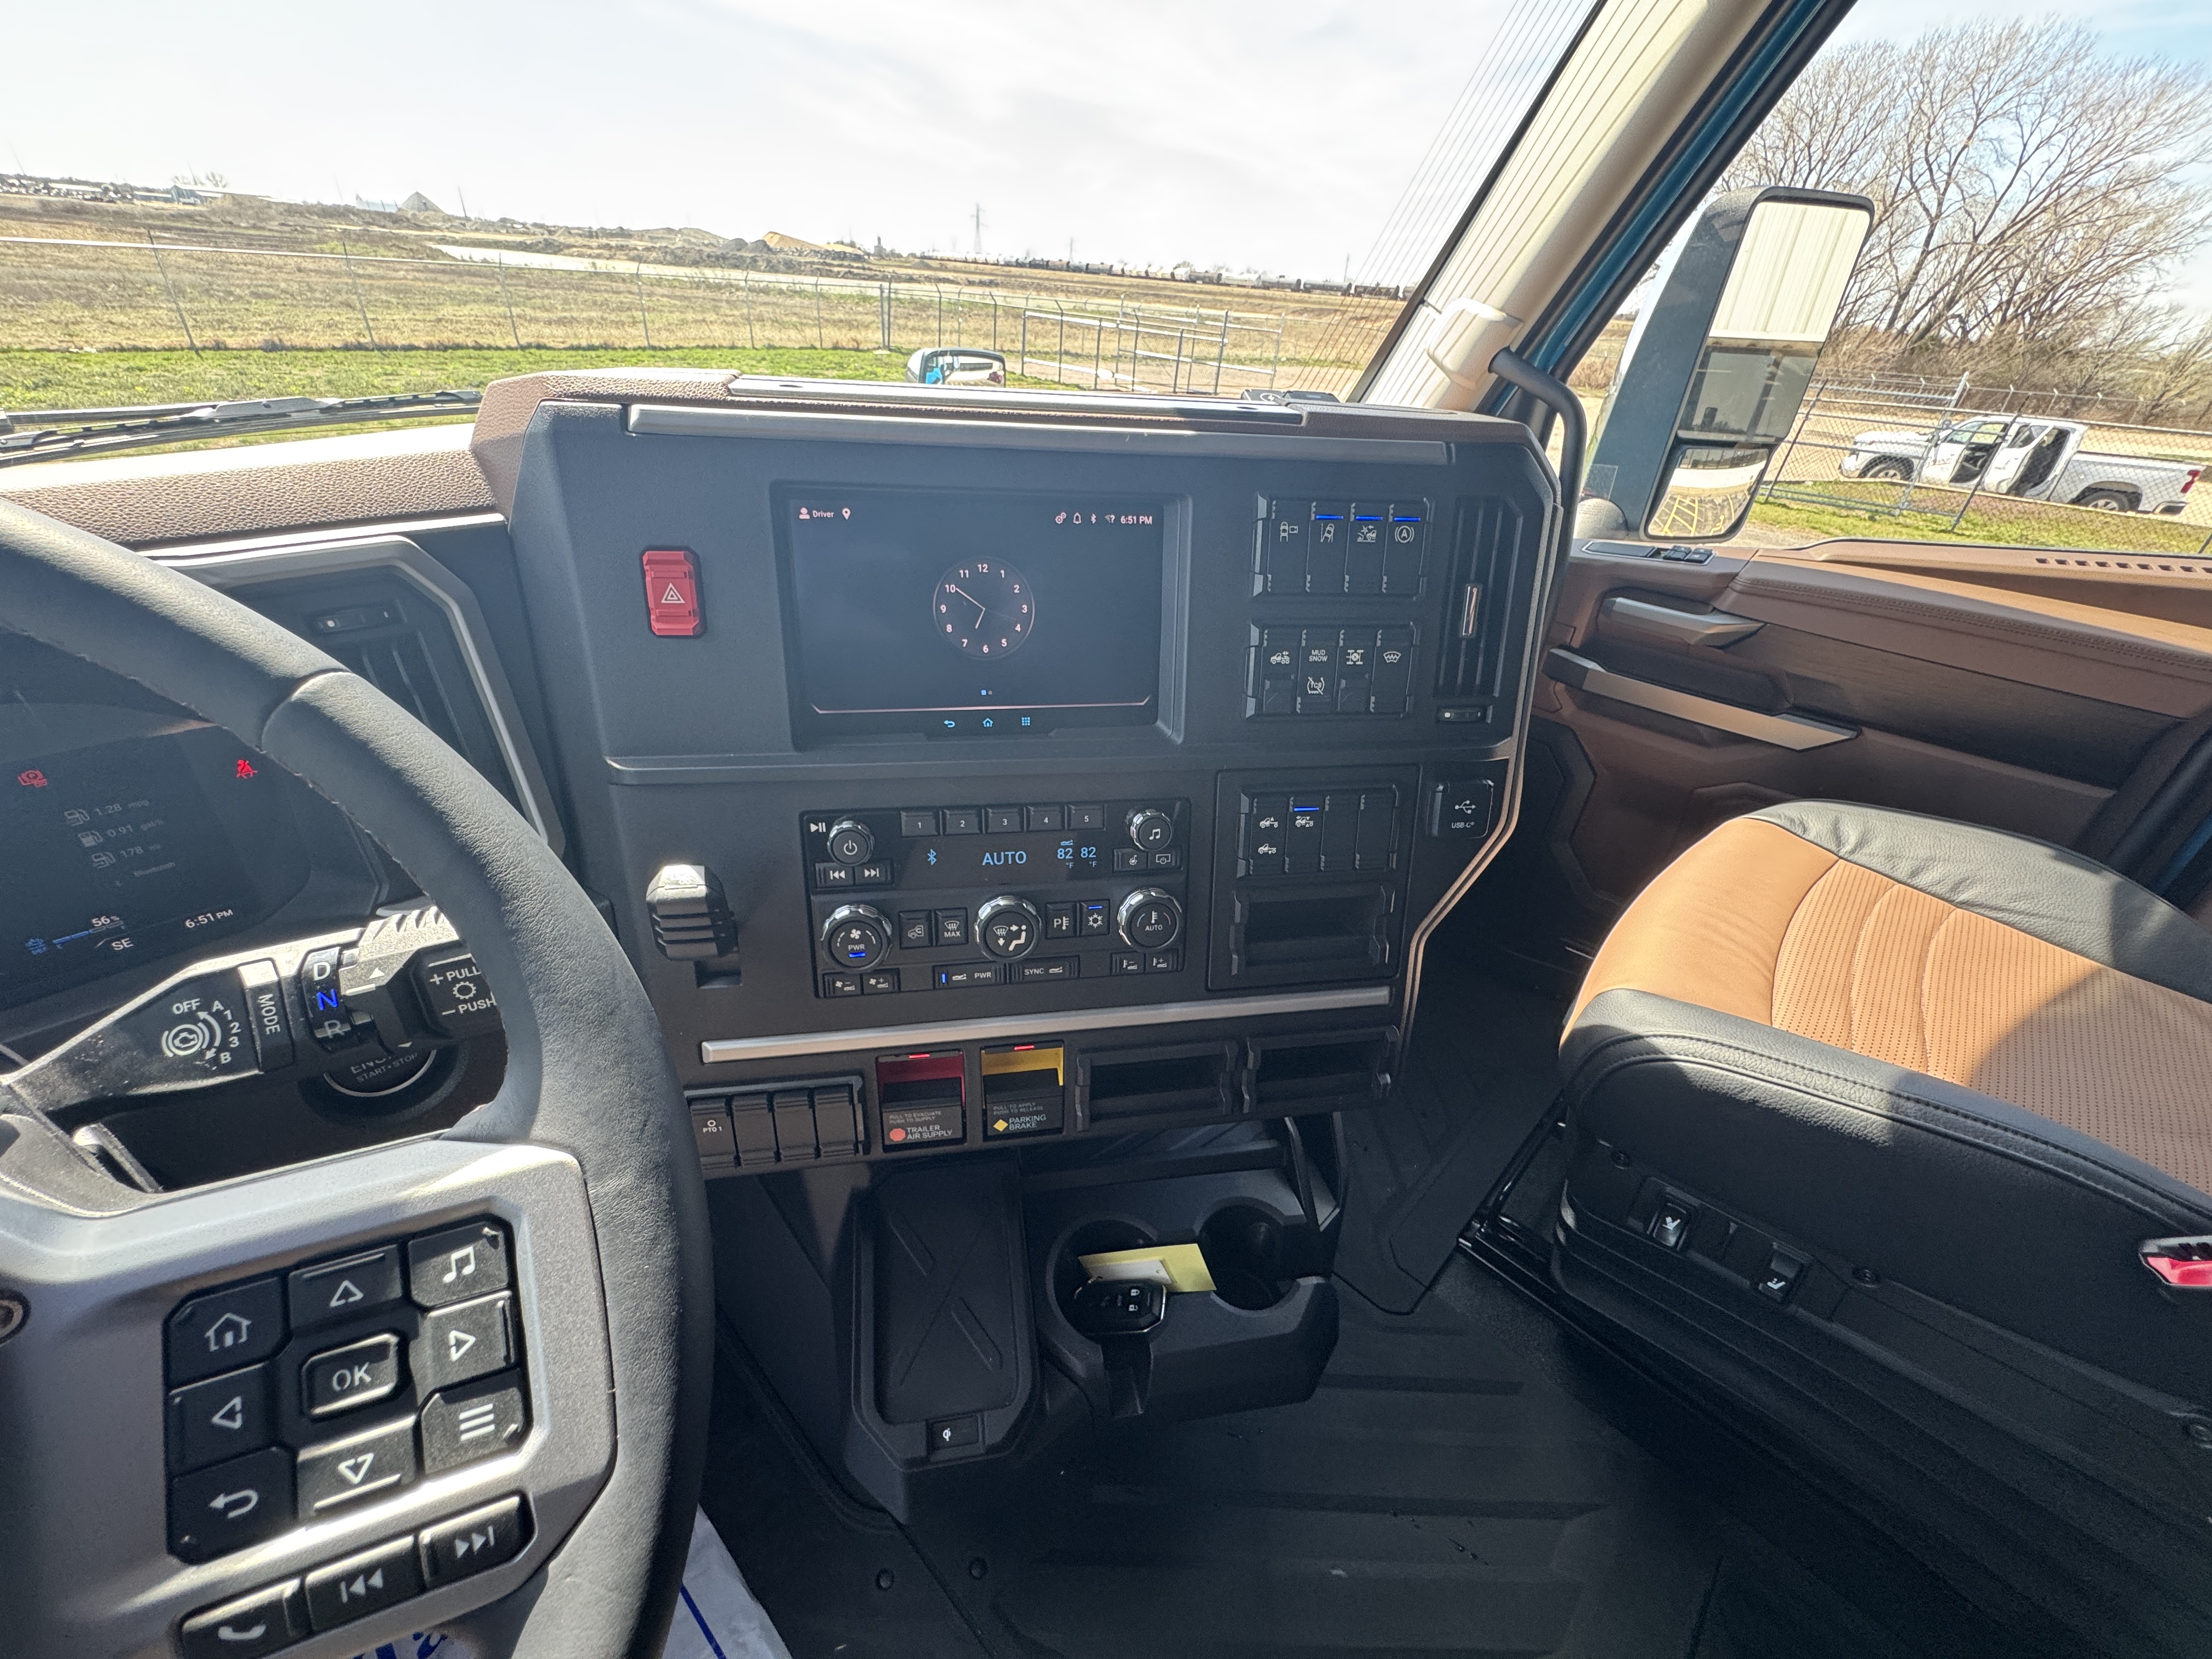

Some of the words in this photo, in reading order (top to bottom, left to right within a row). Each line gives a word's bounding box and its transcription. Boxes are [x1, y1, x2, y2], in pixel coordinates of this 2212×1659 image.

[978, 564, 988, 572] 12
[959, 570, 969, 578] 11
[1001, 570, 1005, 578] 1
[945, 585, 956, 593] 10
[1014, 585, 1019, 593] 2
[940, 605, 946, 613] 9
[1022, 605, 1028, 613] 3
[946, 624, 952, 633] 8
[1015, 624, 1021, 632] 4
[962, 639, 968, 647] 7
[1001, 639, 1007, 647] 5
[983, 645, 989, 653] 6
[982, 851, 1027, 866] AUTO
[1057, 848, 1073, 860] 82
[1081, 847, 1096, 859] 82
[185, 913, 215, 928] 6:51
[216, 909, 234, 919] PM
[1145, 923, 1163, 932] AUTO
[111, 938, 134, 950] SE
[313, 962, 330, 981] D
[446, 966, 481, 981] PULL
[1024, 968, 1045, 976] SYNC
[316, 989, 338, 1011] N
[458, 991, 496, 1014] PUSH
[173, 998, 201, 1014] OFF
[212, 1000, 224, 1012] A
[224, 1010, 232, 1020] 1
[258, 994, 281, 1035] MODE
[229, 1022, 241, 1034] 2
[229, 1036, 240, 1047] 3
[220, 1052, 232, 1064] B
[1009, 1114, 1047, 1124] PARKING
[1009, 1122, 1037, 1130] BRAKE
[922, 1130, 952, 1138] SUPPLY
[332, 1361, 373, 1391] OK
